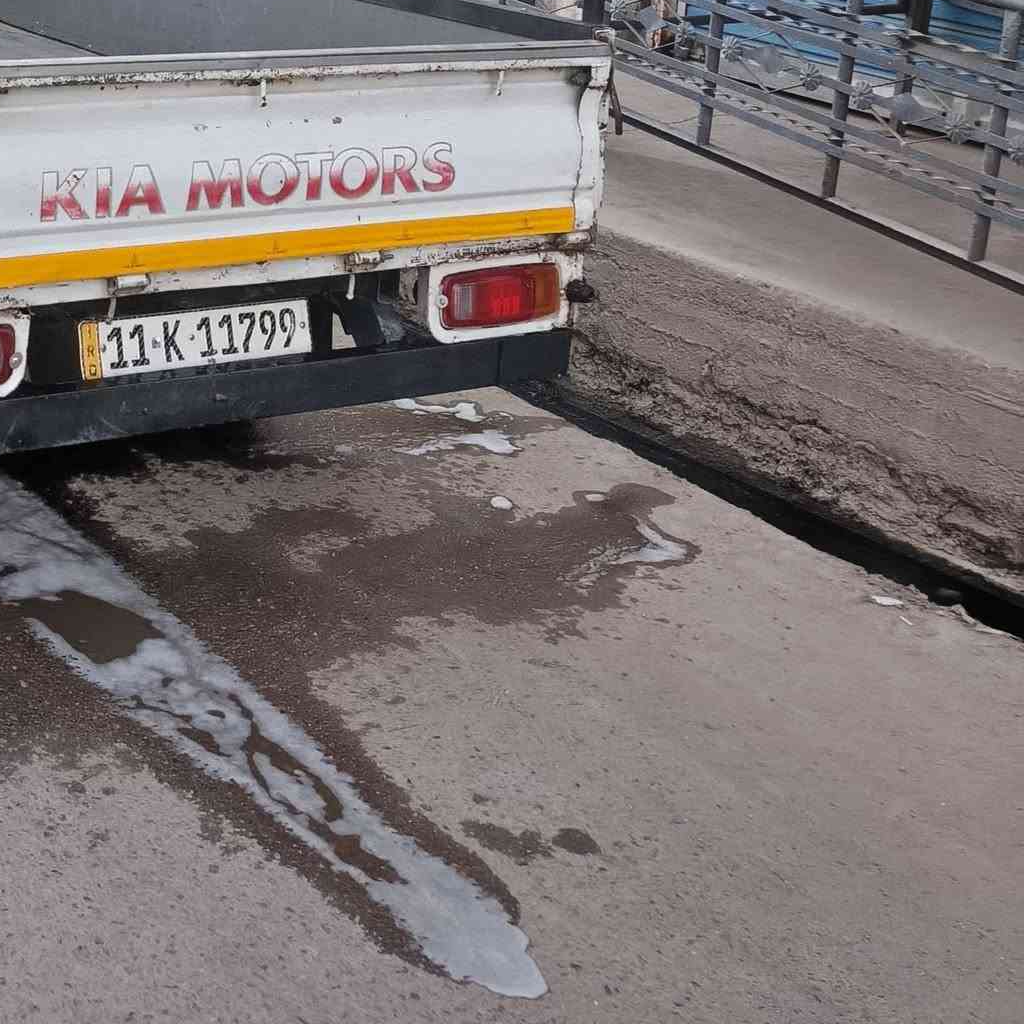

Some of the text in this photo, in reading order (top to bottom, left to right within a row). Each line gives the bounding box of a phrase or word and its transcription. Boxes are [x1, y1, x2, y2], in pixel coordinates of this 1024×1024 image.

[39, 141, 456, 223] KIA MOTORS
[106, 307, 297, 370] 11 K 11799
